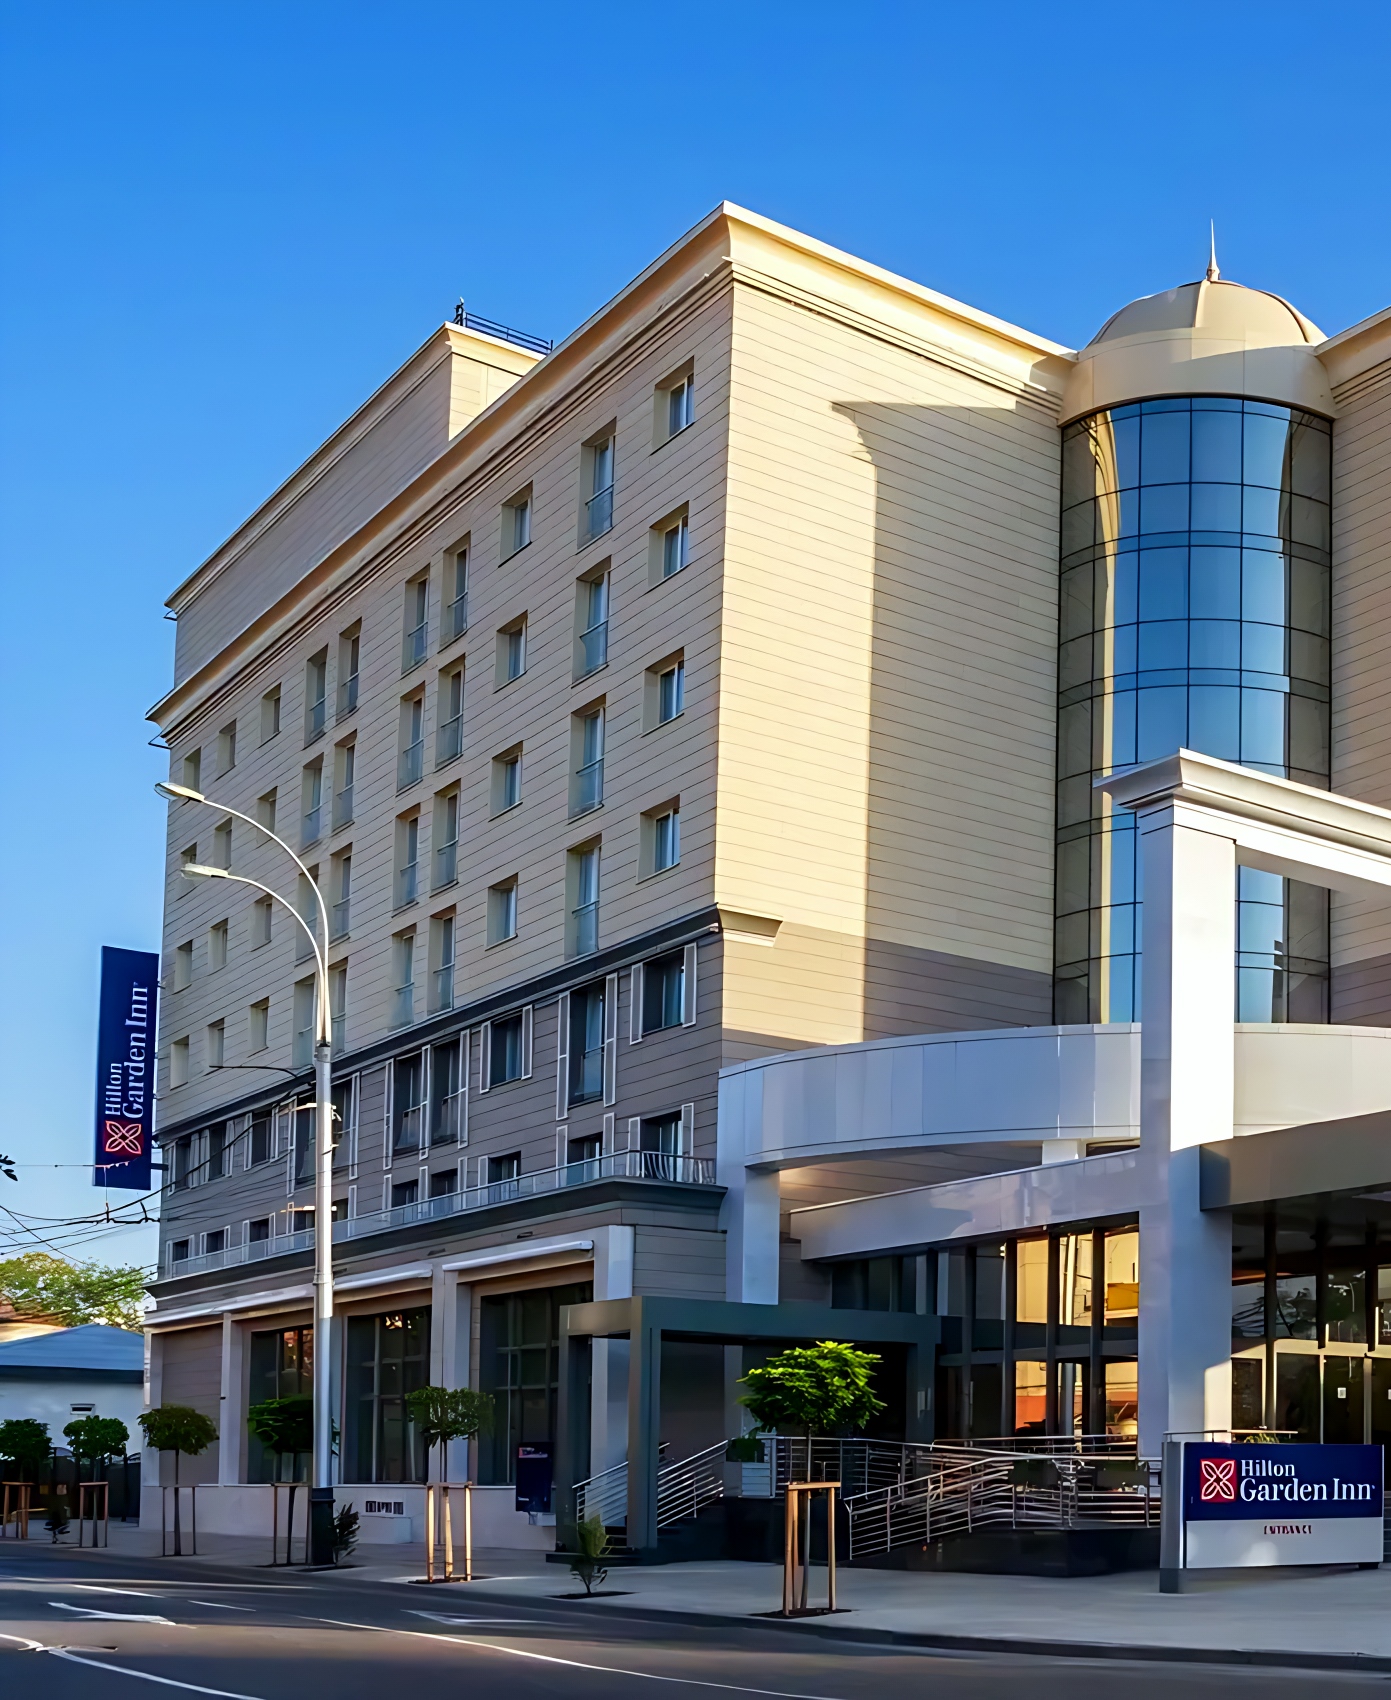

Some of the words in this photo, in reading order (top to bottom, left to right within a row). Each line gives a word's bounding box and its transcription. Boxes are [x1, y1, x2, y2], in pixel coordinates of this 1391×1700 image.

[125, 985, 148, 1028] Inn
[122, 1032, 146, 1119] Garden
[1240, 1459, 1295, 1477] Hilton
[1240, 1477, 1328, 1502] Garden
[1332, 1477, 1371, 1501] Inn
